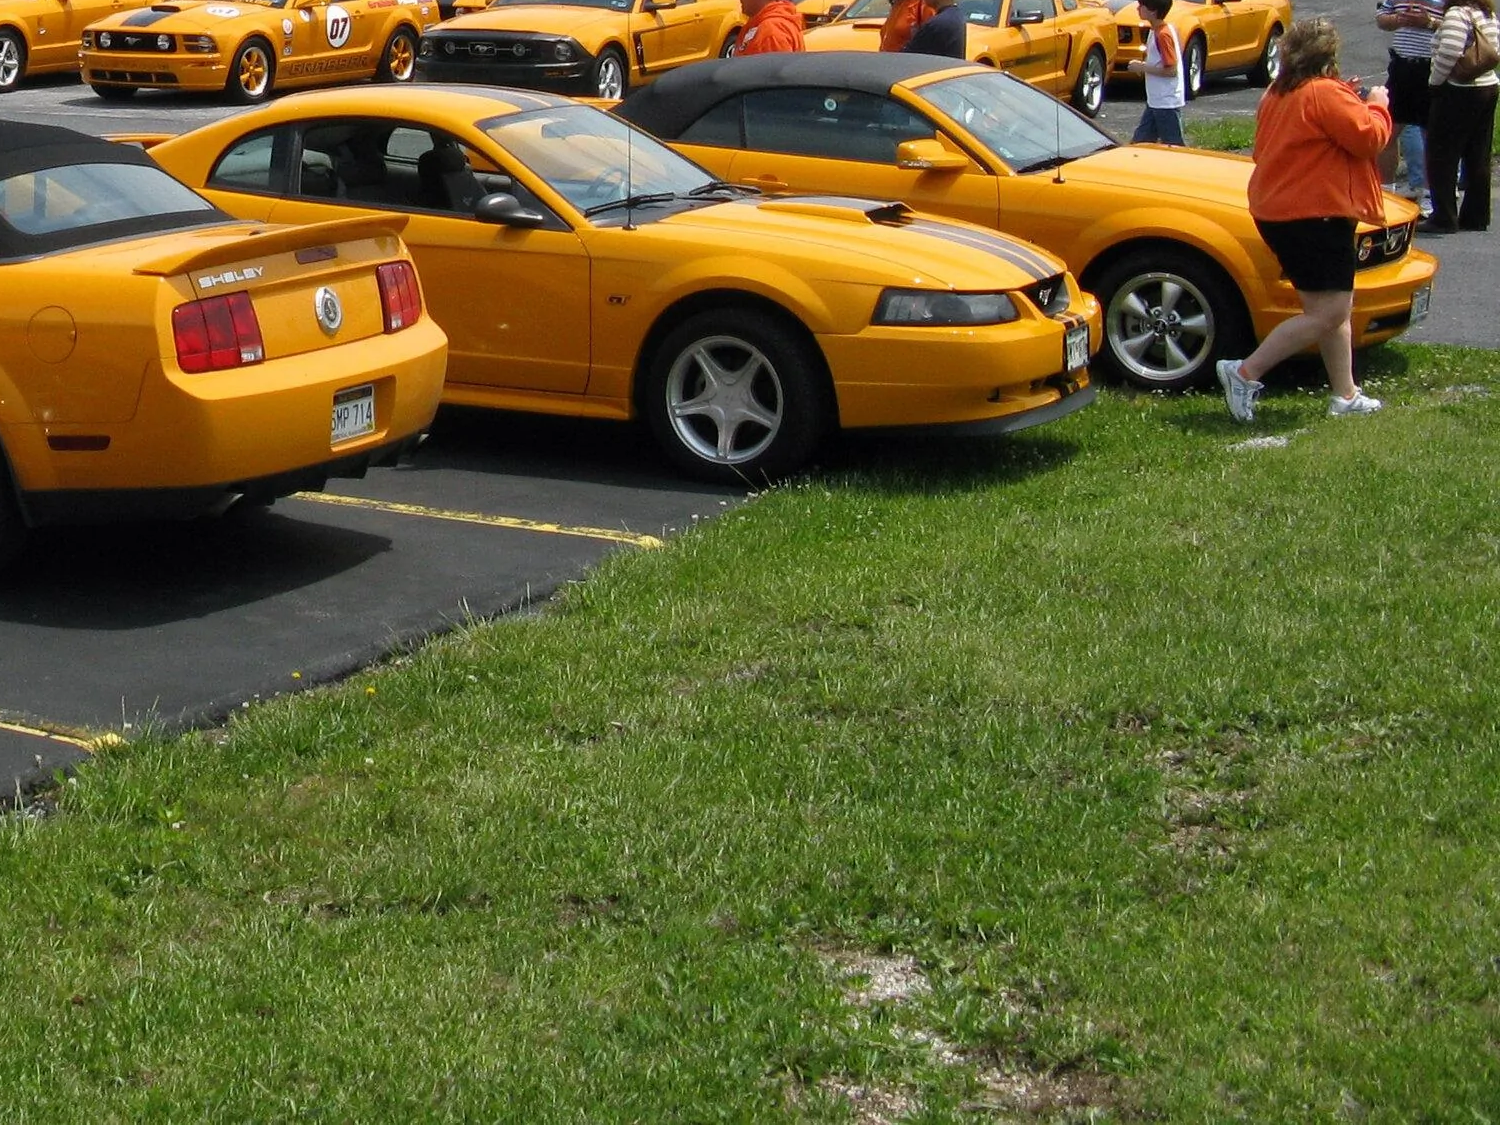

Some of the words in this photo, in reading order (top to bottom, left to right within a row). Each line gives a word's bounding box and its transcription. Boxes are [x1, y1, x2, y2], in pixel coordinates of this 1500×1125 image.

[329, 17, 349, 40] 07
[198, 266, 264, 289] SHELBY
[352, 401, 372, 426] 714
